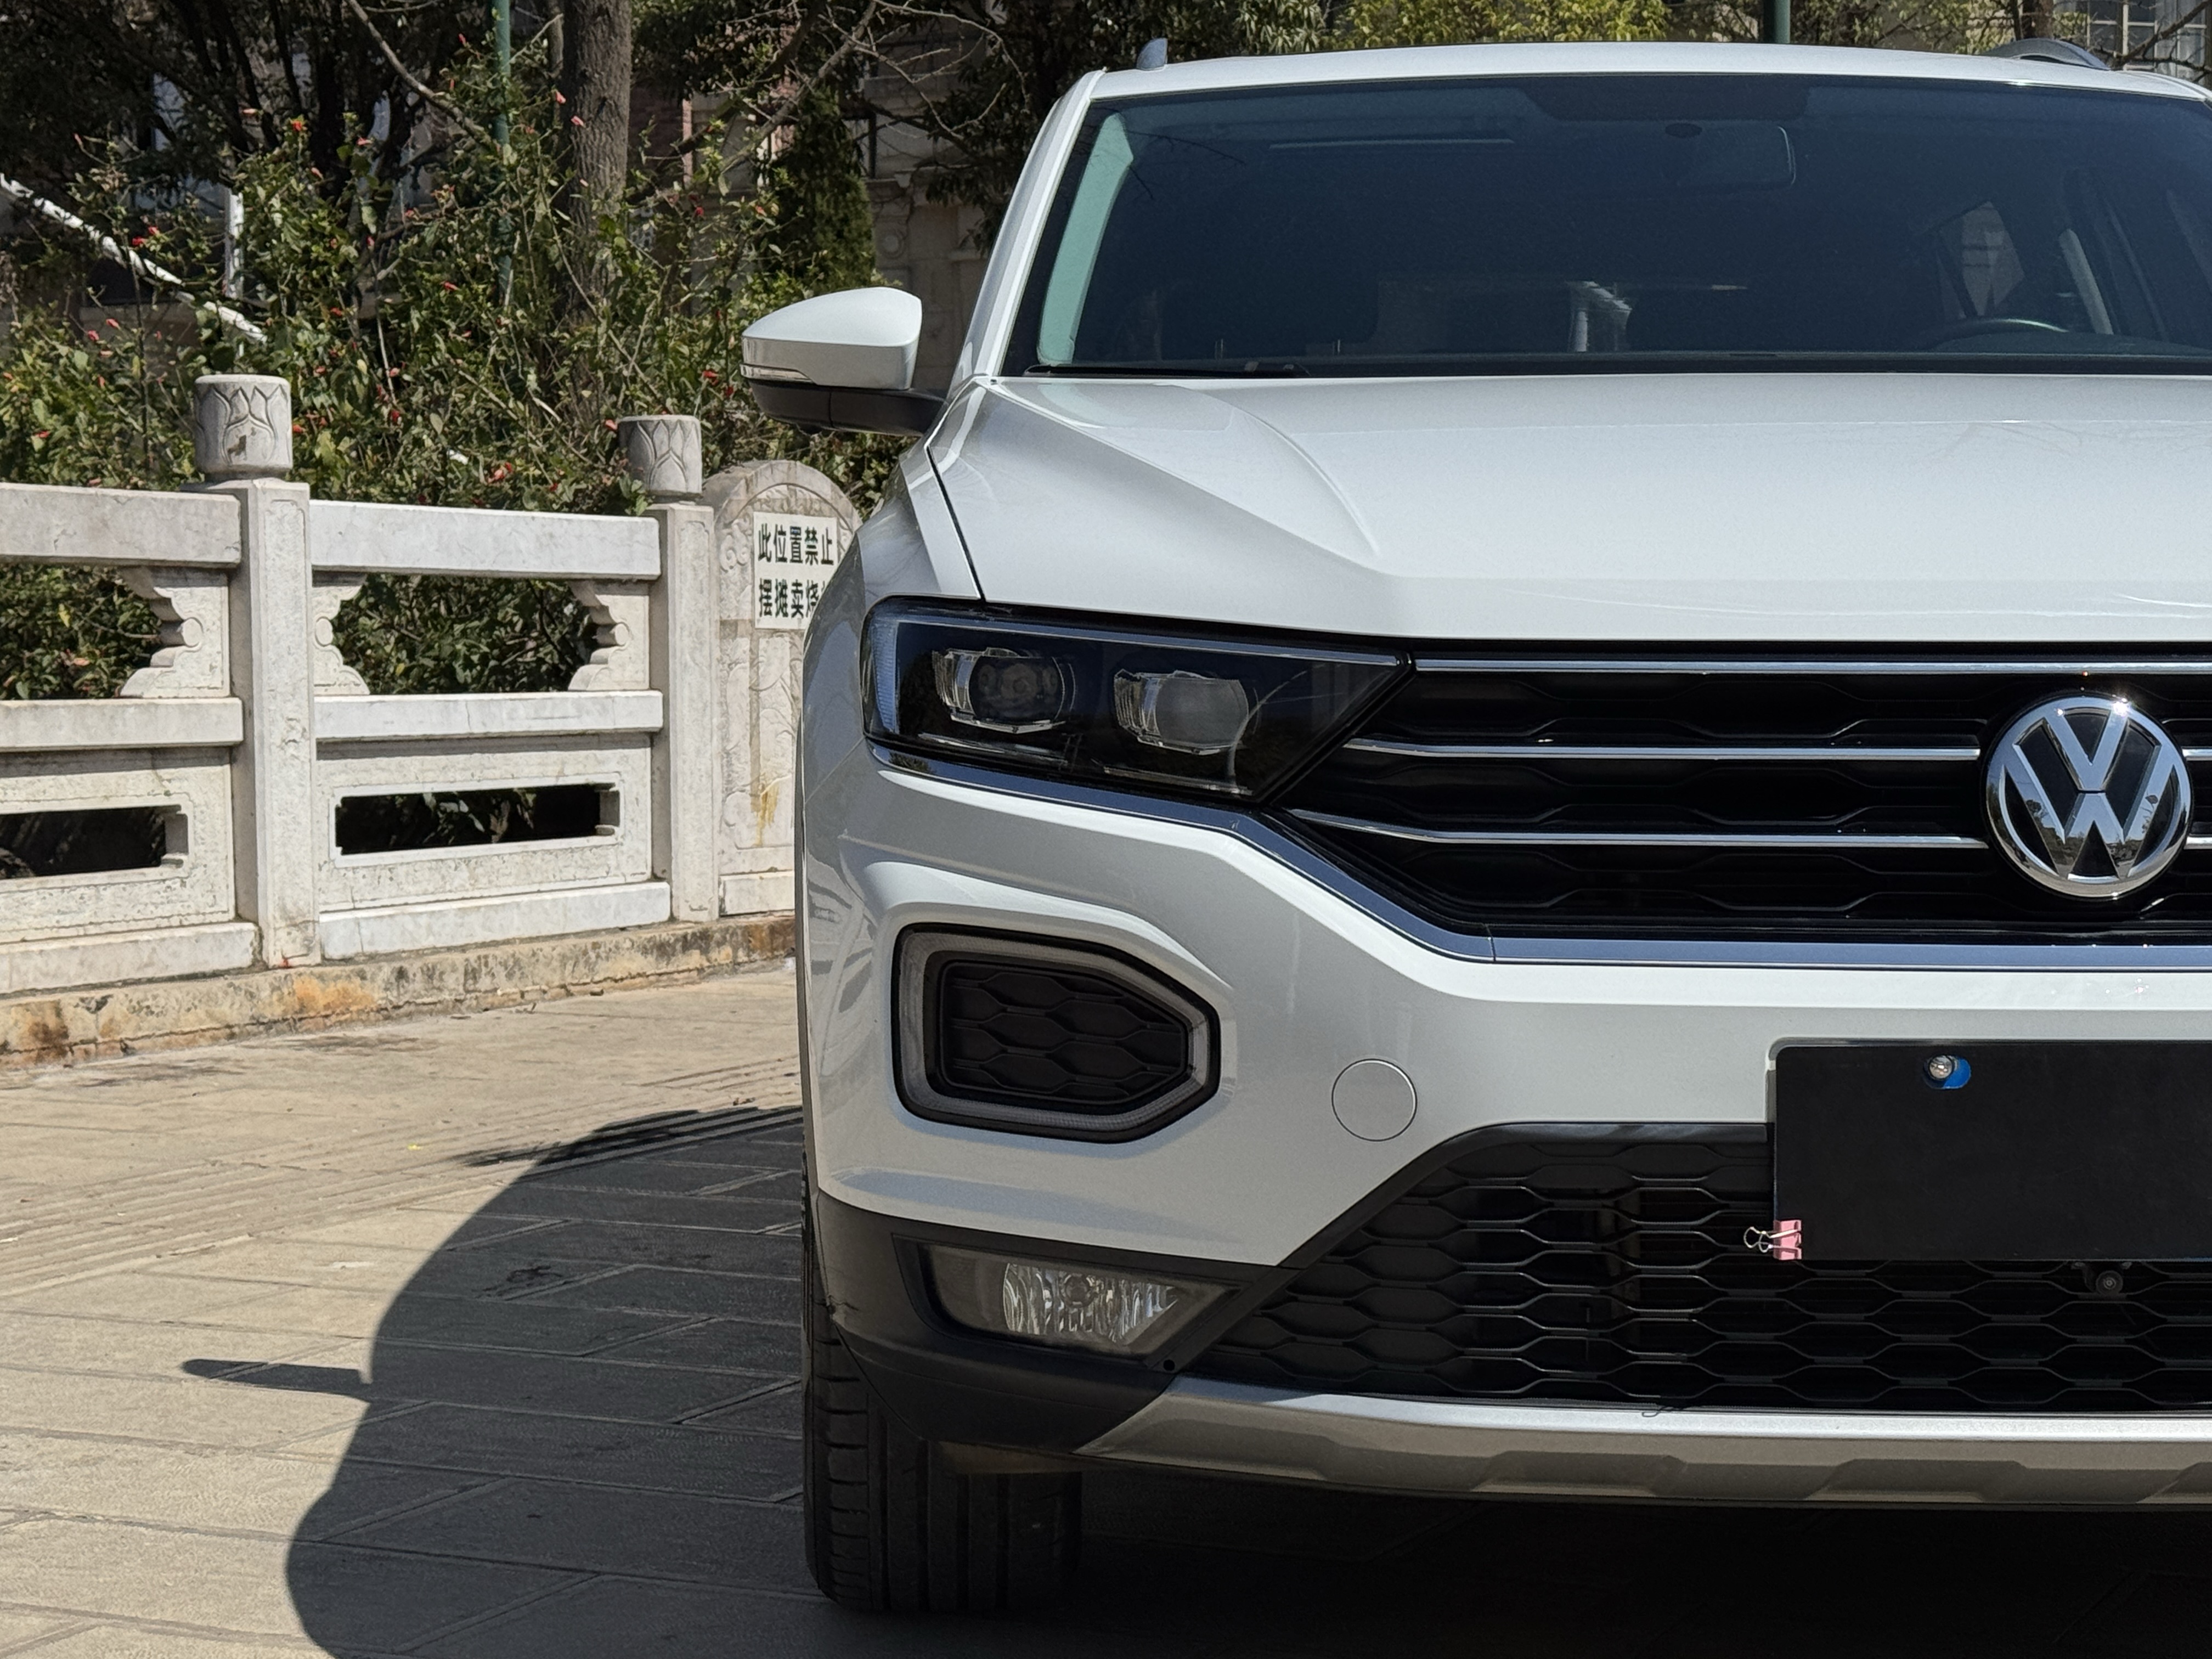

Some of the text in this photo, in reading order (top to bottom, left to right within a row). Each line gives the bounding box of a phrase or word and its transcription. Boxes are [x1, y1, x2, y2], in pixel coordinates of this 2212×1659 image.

[758, 523, 834, 566] 此位置禁止
[759, 578, 825, 618] 摆摊卖烧
[1991, 699, 2185, 890] VW
